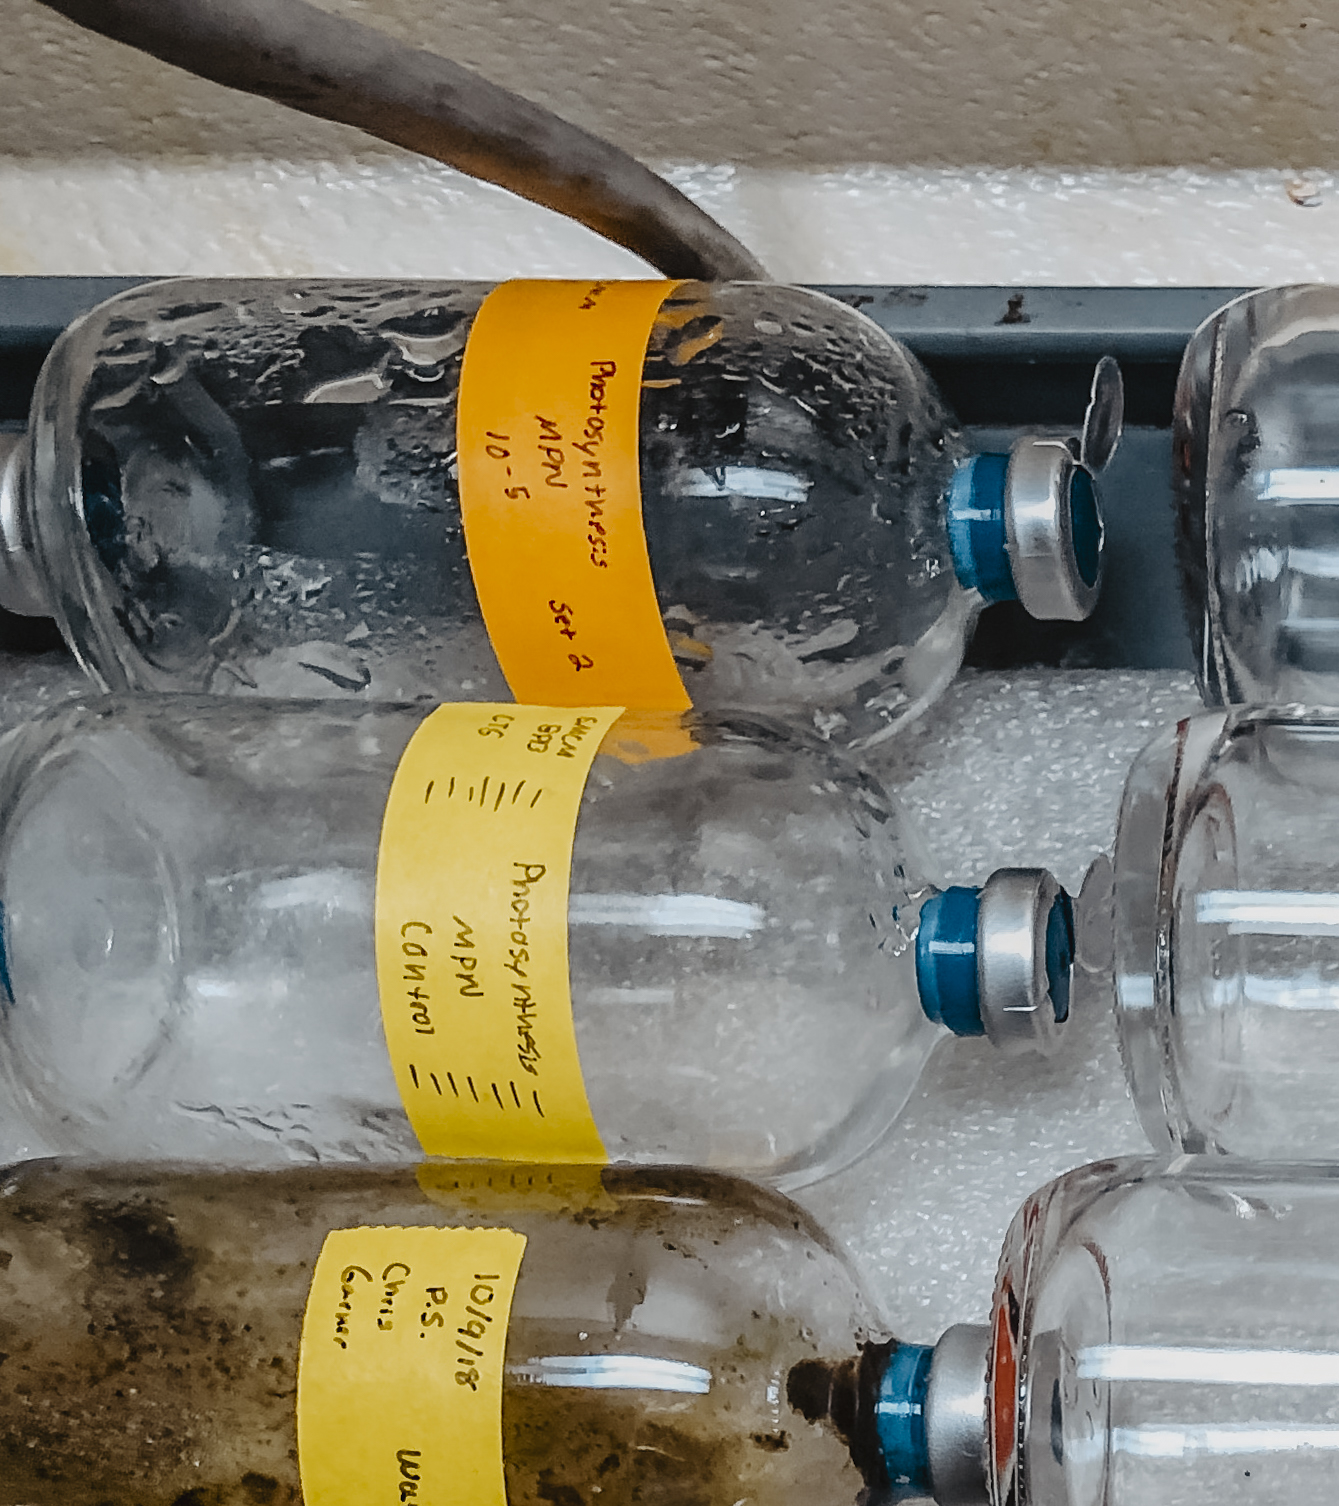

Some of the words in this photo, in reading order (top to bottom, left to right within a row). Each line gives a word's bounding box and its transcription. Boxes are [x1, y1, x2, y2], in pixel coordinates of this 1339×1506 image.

[534, 414, 568, 489] MPN
[549, 600, 577, 641] Set
[568, 653, 594, 672] 2
[401, 921, 435, 1035] Control
[450, 915, 484, 998] MPN
[376, 1262, 411, 1331] Chris
[419, 1287, 448, 1339] P.S.
[454, 1273, 500, 1392] 10/9/18
